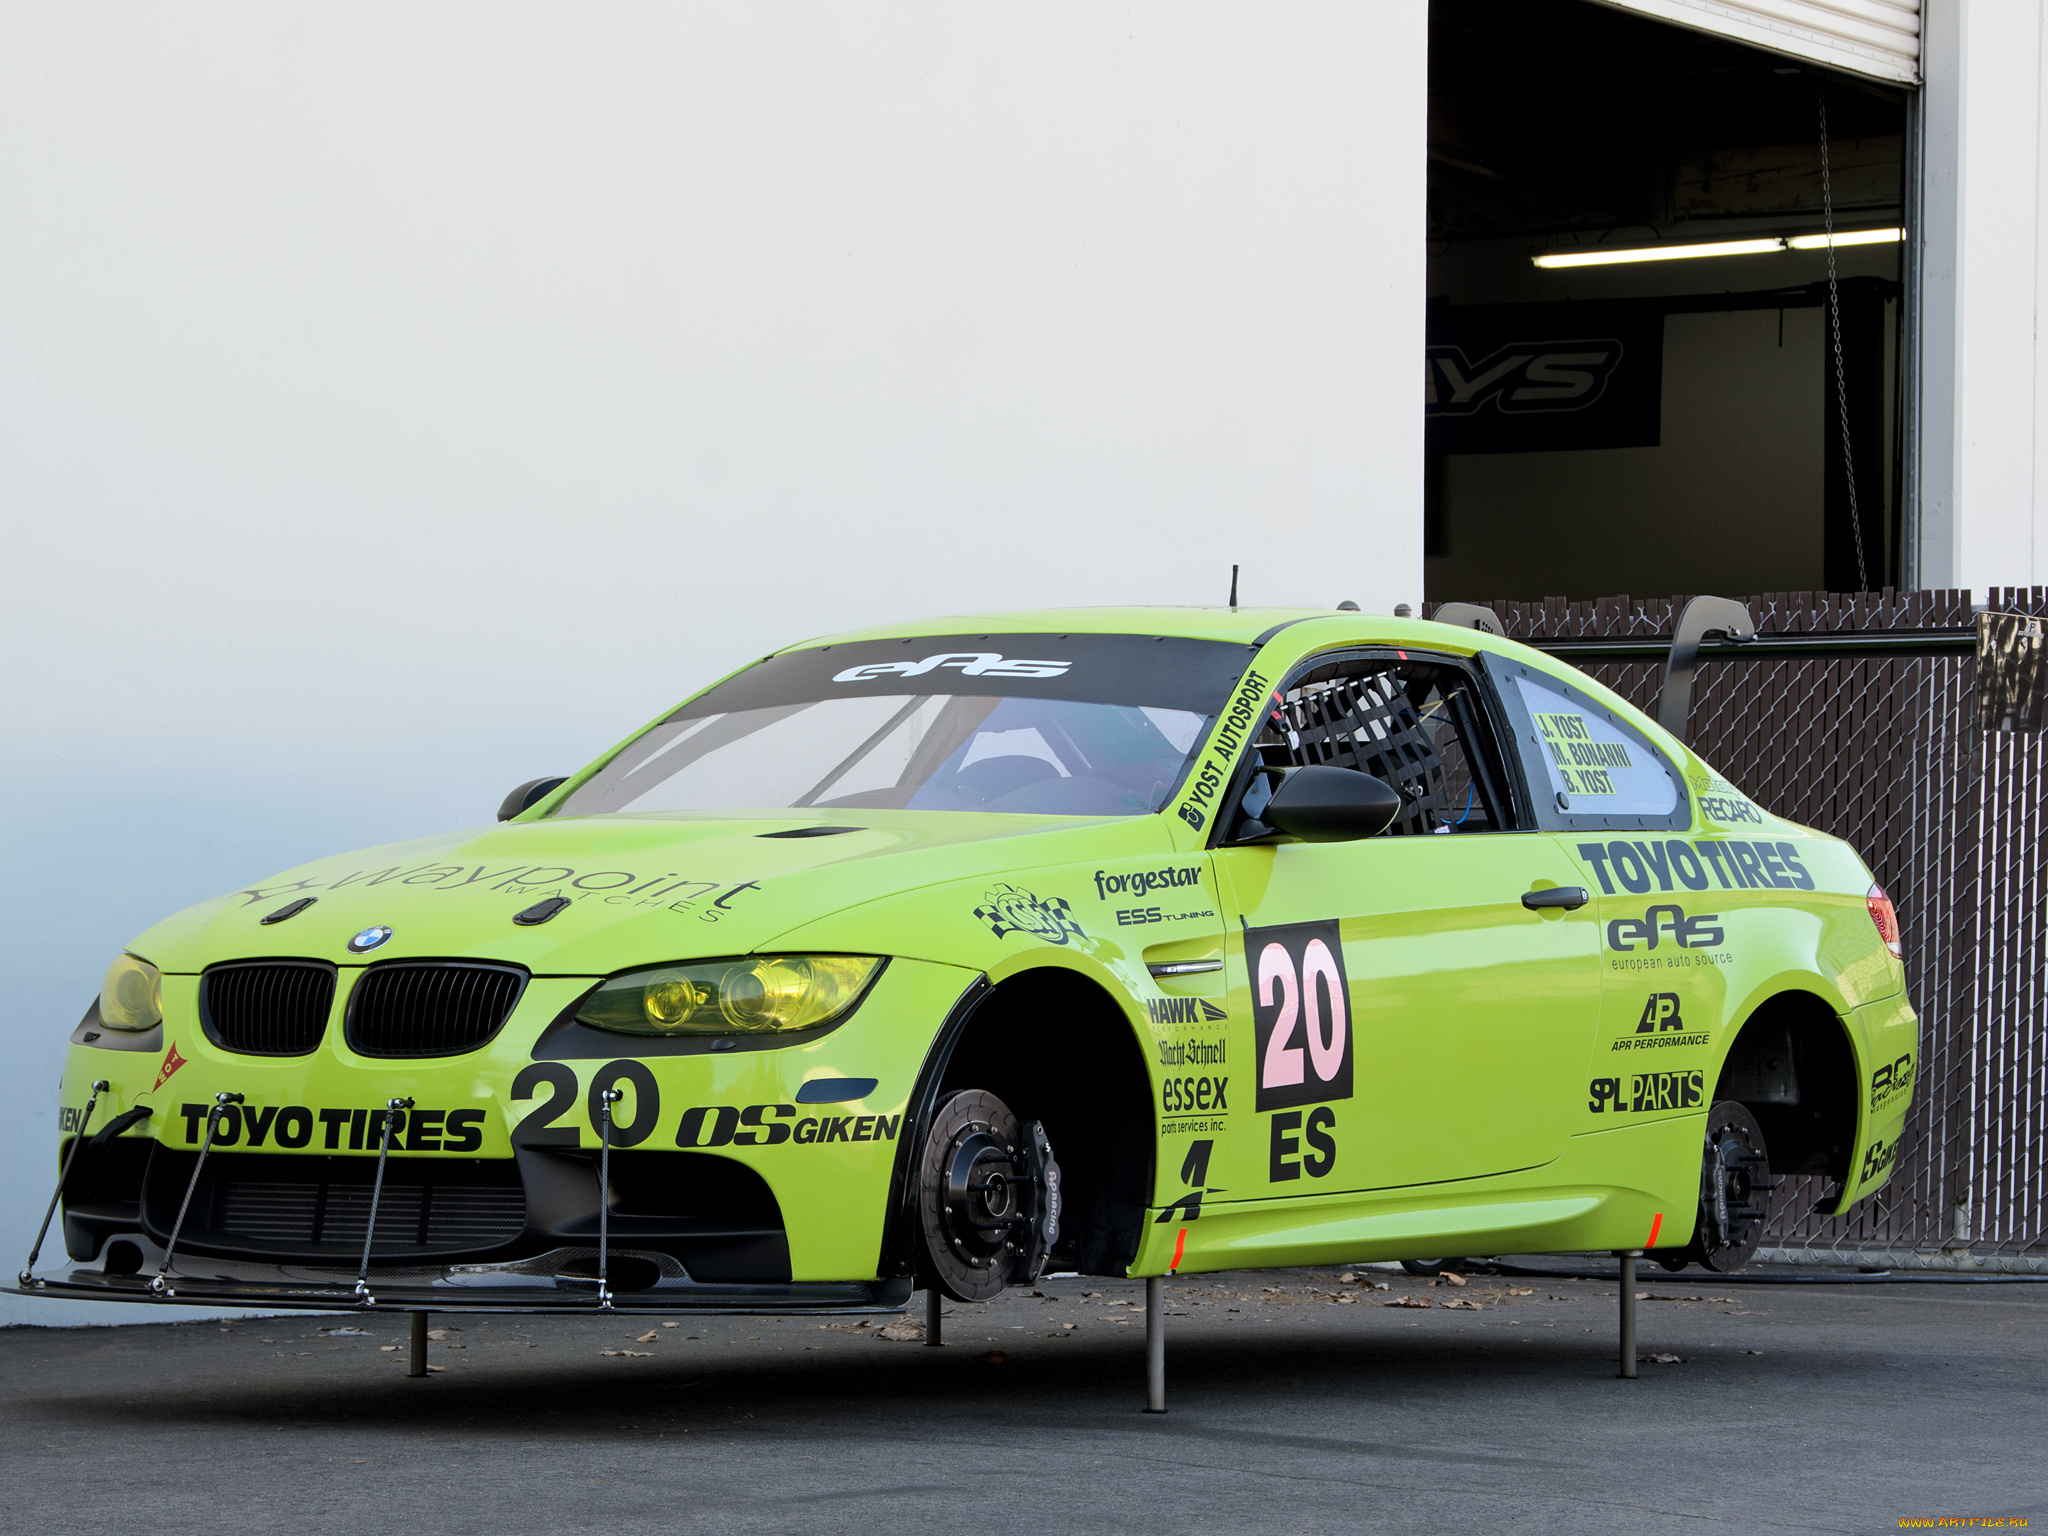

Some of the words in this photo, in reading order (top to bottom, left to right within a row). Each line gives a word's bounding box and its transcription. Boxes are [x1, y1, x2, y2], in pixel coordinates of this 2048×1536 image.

[1538, 714, 1555, 738] J.
[1549, 715, 1589, 739] YOST
[1548, 742, 1571, 765] M.
[1567, 742, 1632, 767] BONANNI
[1560, 769, 1580, 793] B.
[1575, 769, 1614, 793] YOST
[1697, 796, 1762, 824] RECARO
[1576, 839, 1710, 894] TOYO
[1693, 840, 1815, 890] TIRES
[328, 862, 761, 910] Waypoint
[1094, 866, 1201, 900] forgestar
[504, 886, 724, 924] WATCHES
[1115, 907, 1162, 926] ESS
[1162, 910, 1214, 921] TUNING
[1611, 955, 1663, 972] european
[1667, 954, 1690, 967] auto
[1695, 952, 1733, 966] source
[1147, 998, 1199, 1024] HAWK
[1257, 938, 1346, 1090] 20
[1152, 1024, 1229, 1032] PERFORMANCE
[1611, 1040, 1632, 1052] APR
[1633, 1034, 1710, 1050] PERFORMANCE
[158, 1053, 179, 1083] TOW
[1185, 1038, 1226, 1070] Schnell
[510, 1059, 660, 1148] 20
[1162, 1075, 1229, 1112] essex
[1588, 1077, 1628, 1114] SPL
[1631, 1070, 1703, 1112] PARTS
[180, 1103, 314, 1149] TOYO
[319, 1108, 486, 1152] TIRES
[1161, 1119, 1177, 1137] parts
[1178, 1118, 1208, 1134] services
[1210, 1118, 1227, 1132] inc.
[1269, 1106, 1336, 1183] ES
